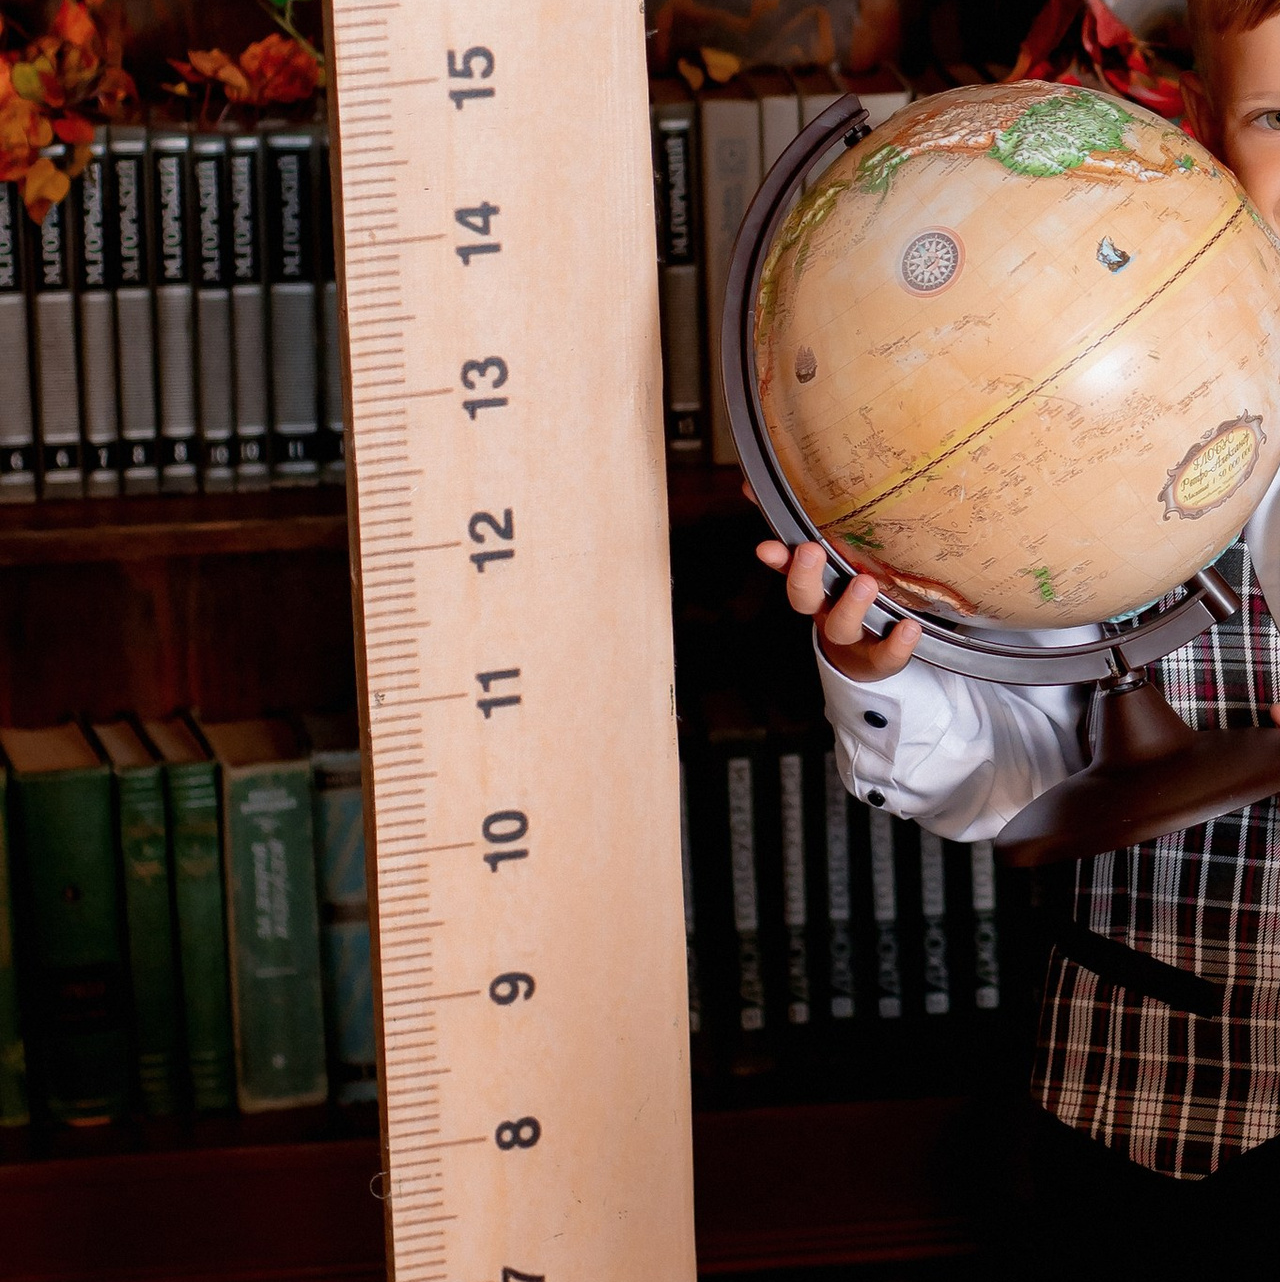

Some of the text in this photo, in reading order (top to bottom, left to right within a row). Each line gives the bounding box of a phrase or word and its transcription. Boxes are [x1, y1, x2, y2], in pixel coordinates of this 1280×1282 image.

[447, 46, 494, 109] 15
[454, 201, 500, 265] 14
[461, 357, 508, 420] 13
[468, 508, 514, 572] 12
[476, 668, 521, 719] 11
[482, 810, 528, 872] 10
[488, 971, 535, 1005] 9
[494, 1116, 541, 1150] 8
